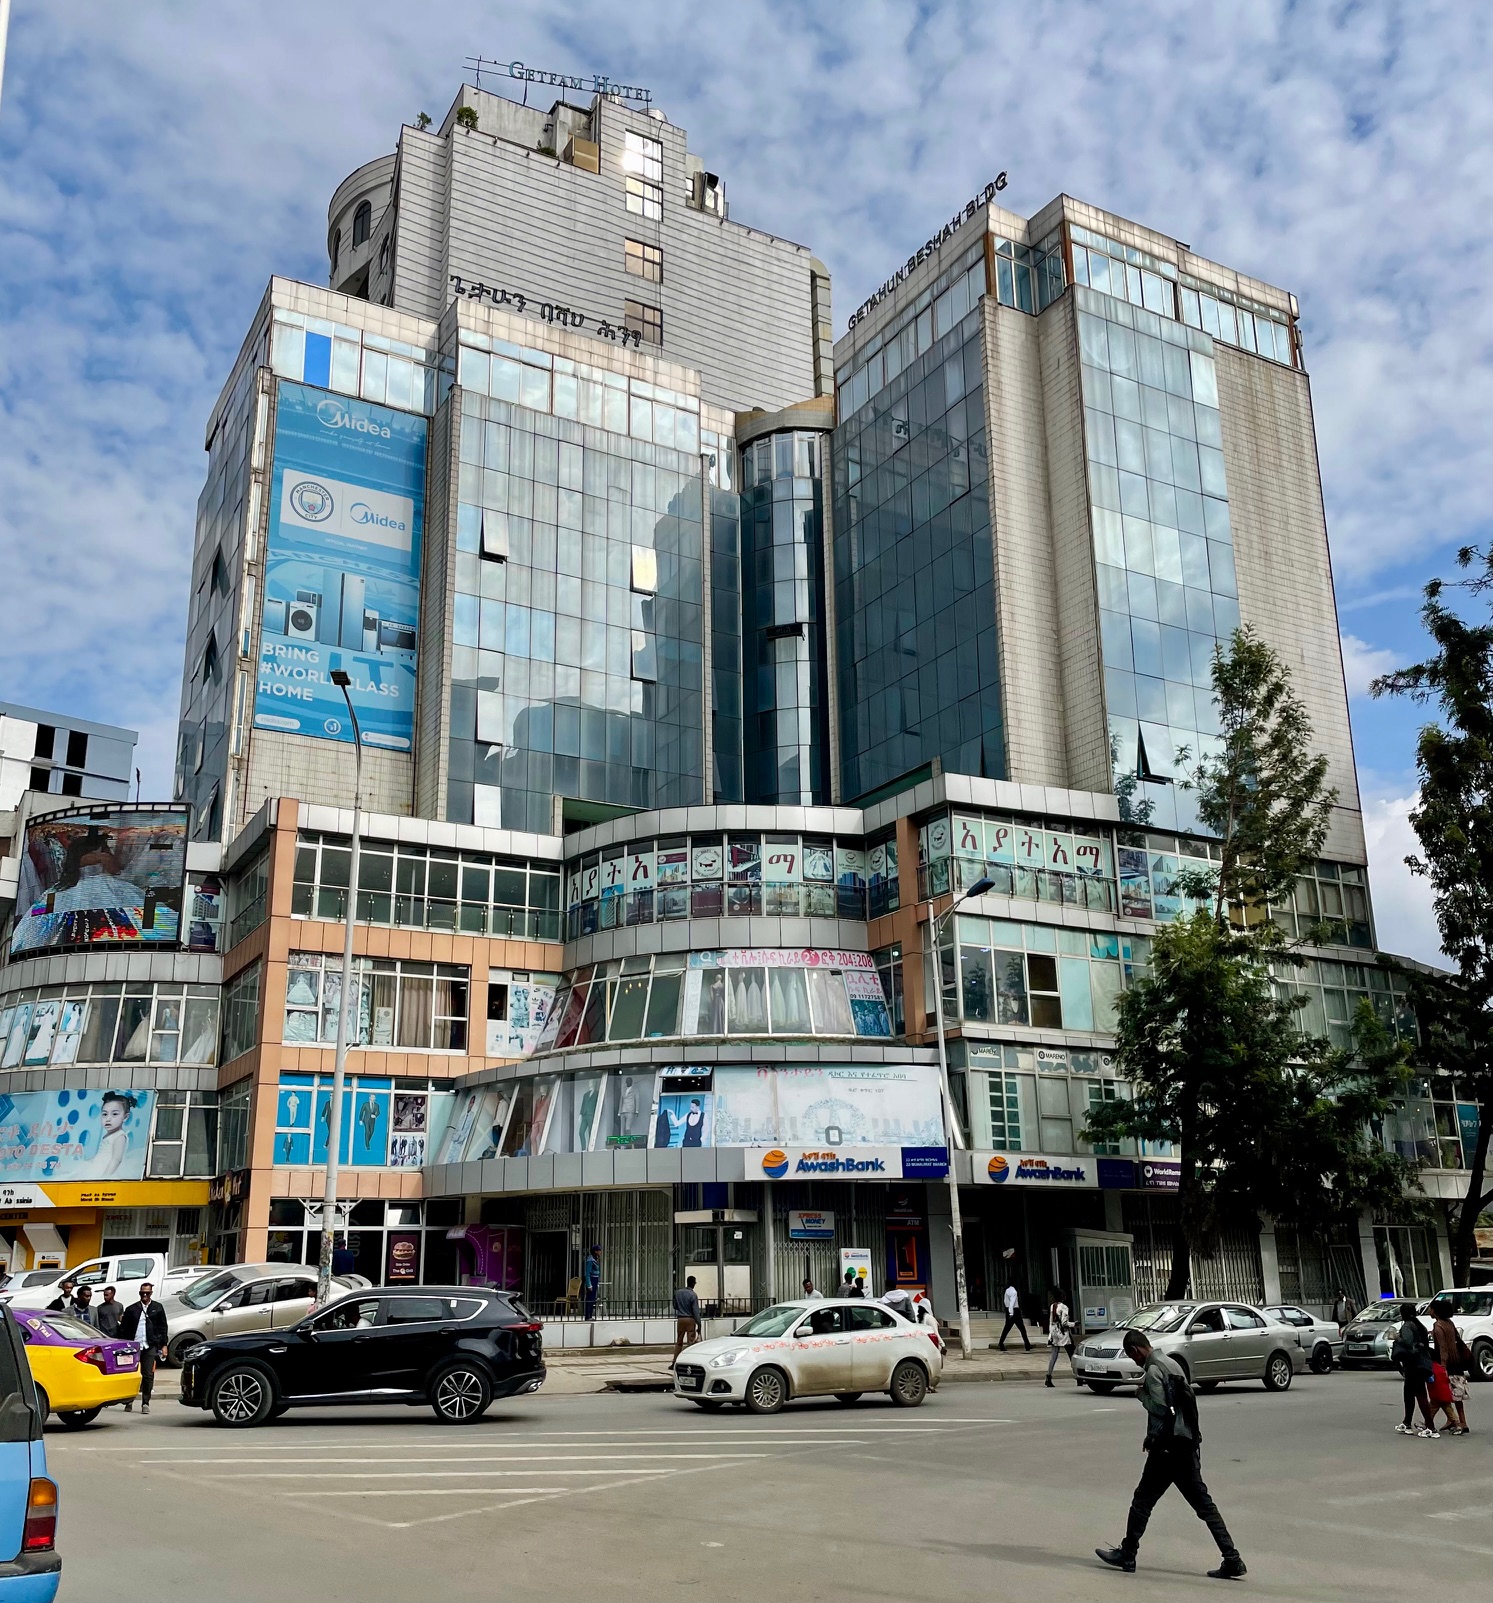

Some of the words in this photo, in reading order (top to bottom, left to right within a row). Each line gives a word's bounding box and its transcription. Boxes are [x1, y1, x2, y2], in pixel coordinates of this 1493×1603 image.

[509, 61, 583, 90] GETFAM
[593, 75, 652, 102] HOTEL
[848, 266, 904, 331] GETAHUN
[907, 211, 962, 276] BESHAH
[965, 171, 1008, 222] BLDG
[450, 275, 526, 312] ጌታሁን
[321, 404, 391, 438] Midea
[296, 485, 329, 501] MANCHESTER
[353, 505, 406, 531] Midea
[262, 642, 320, 664] BRING
[260, 661, 399, 698] #WORLCLASS
[259, 681, 314, 702] HOME
[30, 1144, 83, 1156] DESTA
[795, 1158, 885, 1173] AwashBank
[1015, 1166, 1086, 1181] AwashBank
[39, 1325, 52, 1338] Taxi
